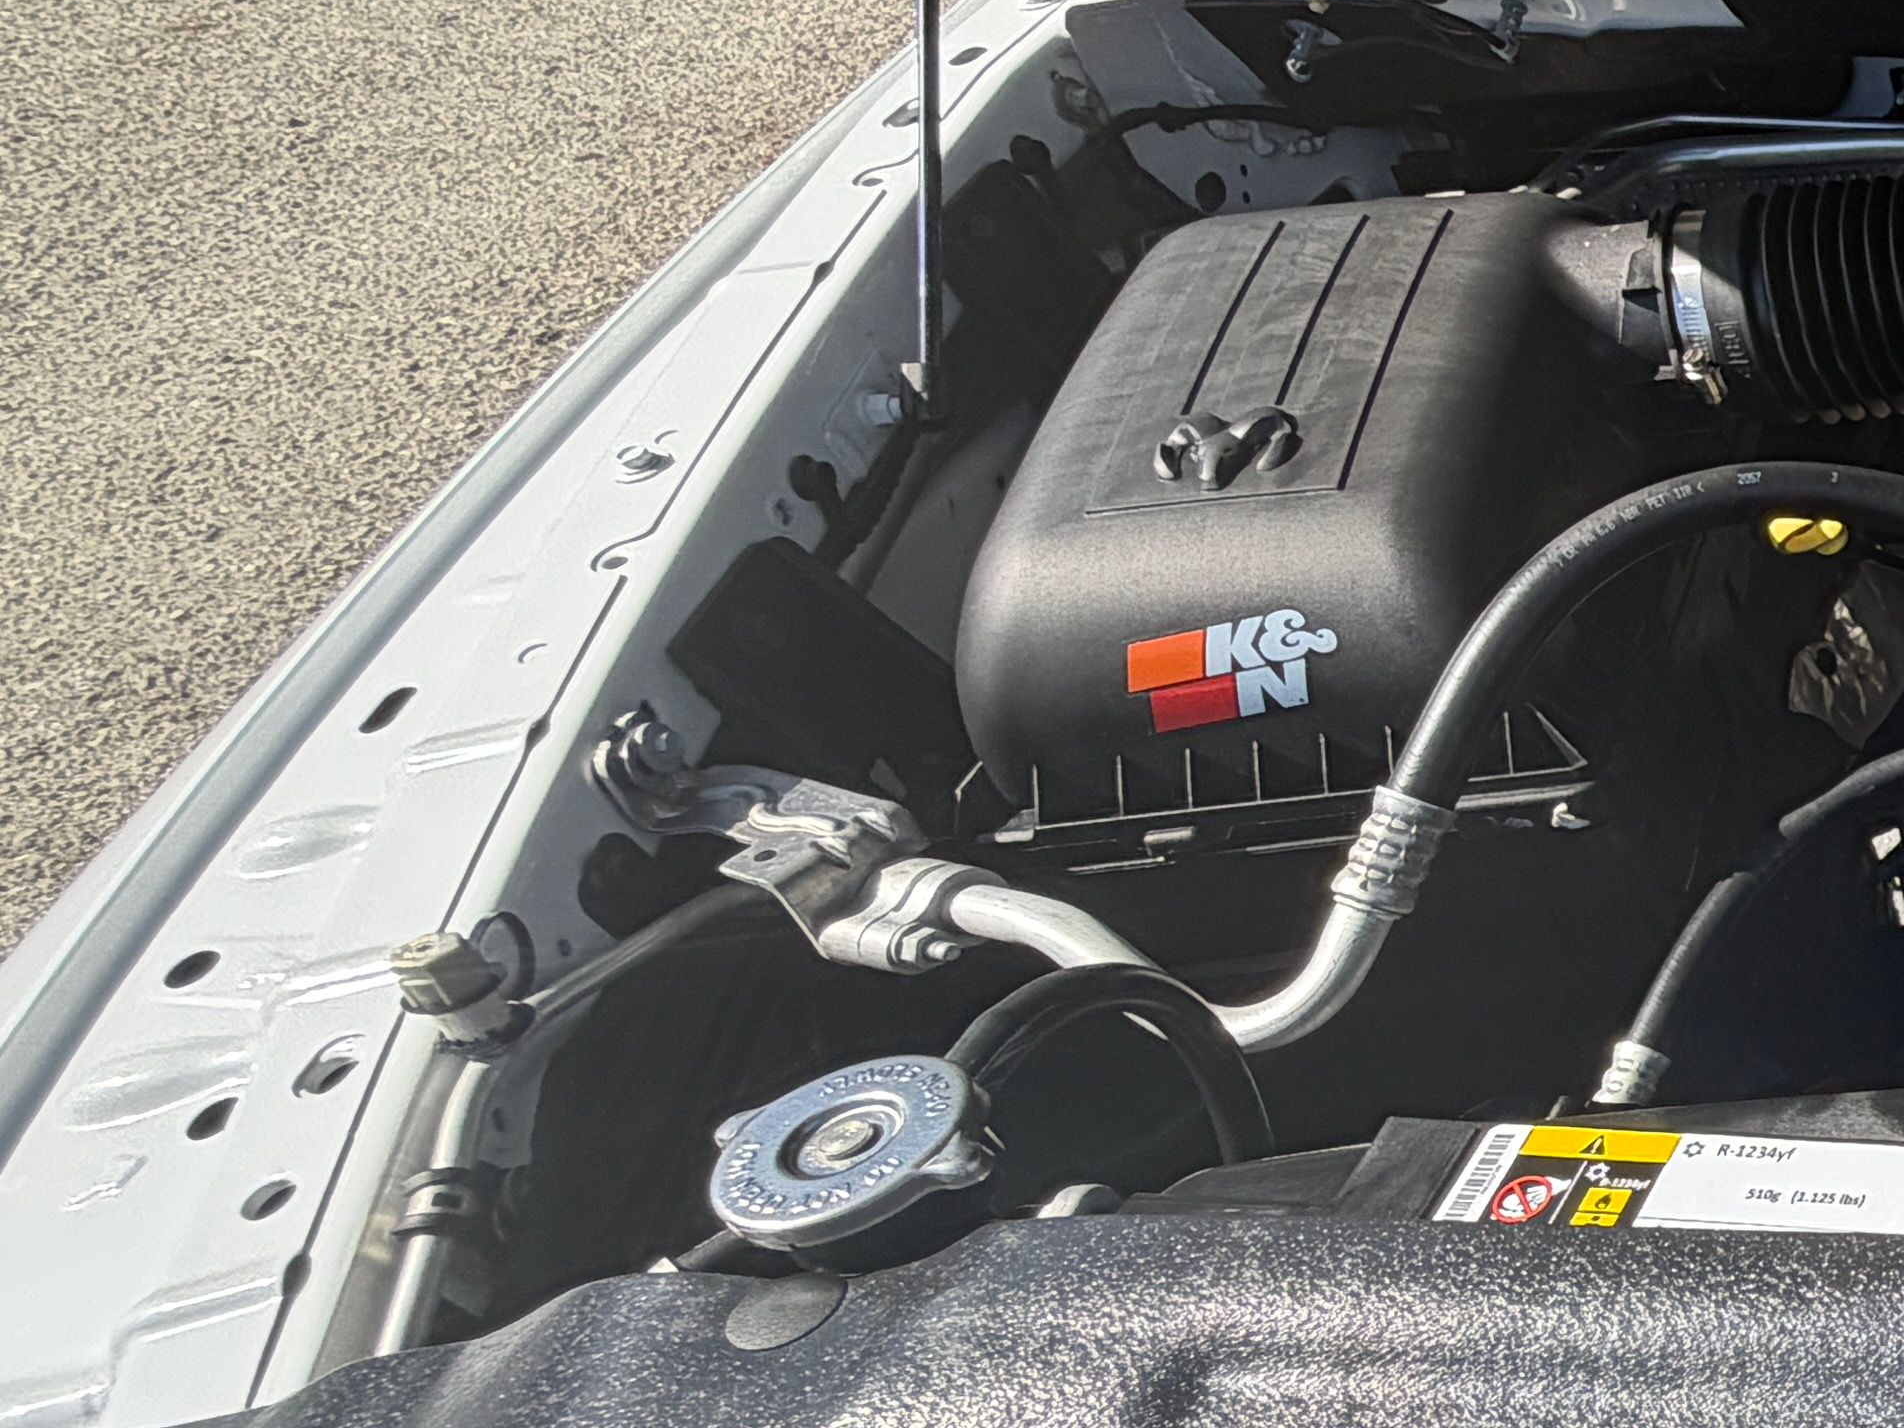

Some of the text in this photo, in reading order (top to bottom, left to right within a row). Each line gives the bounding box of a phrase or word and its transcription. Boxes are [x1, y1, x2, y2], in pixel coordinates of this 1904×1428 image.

[1716, 1143, 1798, 1163] R-1234yf
[1744, 1187, 1783, 1203] 510g
[1790, 1189, 1837, 1205] (1.125
